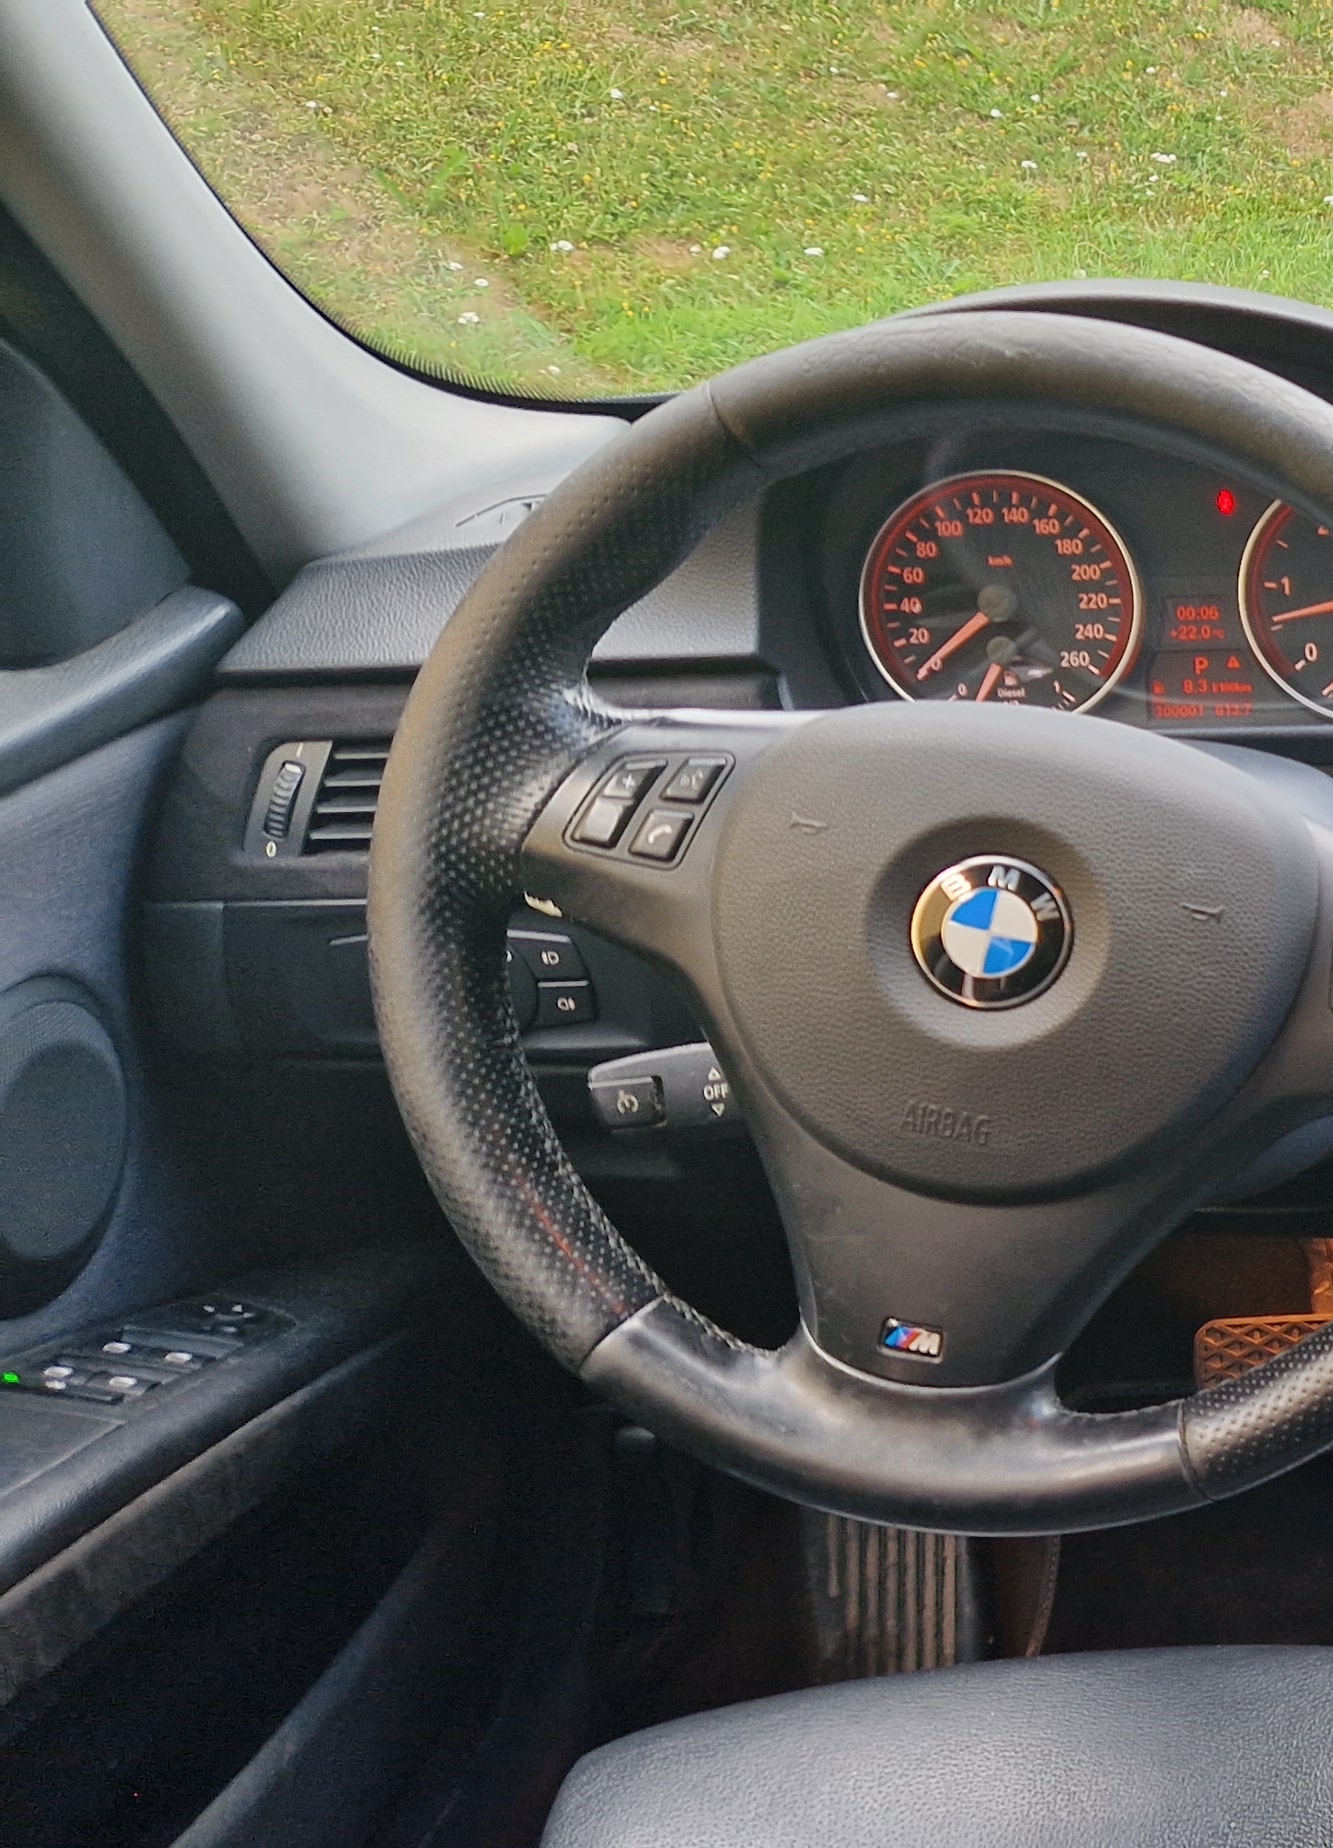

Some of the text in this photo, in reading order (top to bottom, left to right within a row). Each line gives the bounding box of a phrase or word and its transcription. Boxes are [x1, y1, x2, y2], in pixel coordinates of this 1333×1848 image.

[967, 509, 993, 524] 120
[1002, 508, 1028, 524] 140
[936, 521, 963, 537] 100
[1033, 519, 1060, 534] 160
[916, 542, 937, 557] 80
[1056, 539, 1082, 555] 180
[903, 568, 923, 583] 60
[1071, 565, 1100, 580] 200
[900, 599, 922, 613] 40
[1079, 593, 1107, 609] 220
[909, 628, 929, 644] 20
[1075, 624, 1103, 639] 240
[1061, 652, 1089, 667] 260
[1304, 642, 1317, 661] 0
[1194, 656, 1208, 674] P
[941, 865, 1059, 922] BMW
[703, 1083, 729, 1100] OFF
[901, 1100, 992, 1146] AIRBAG
